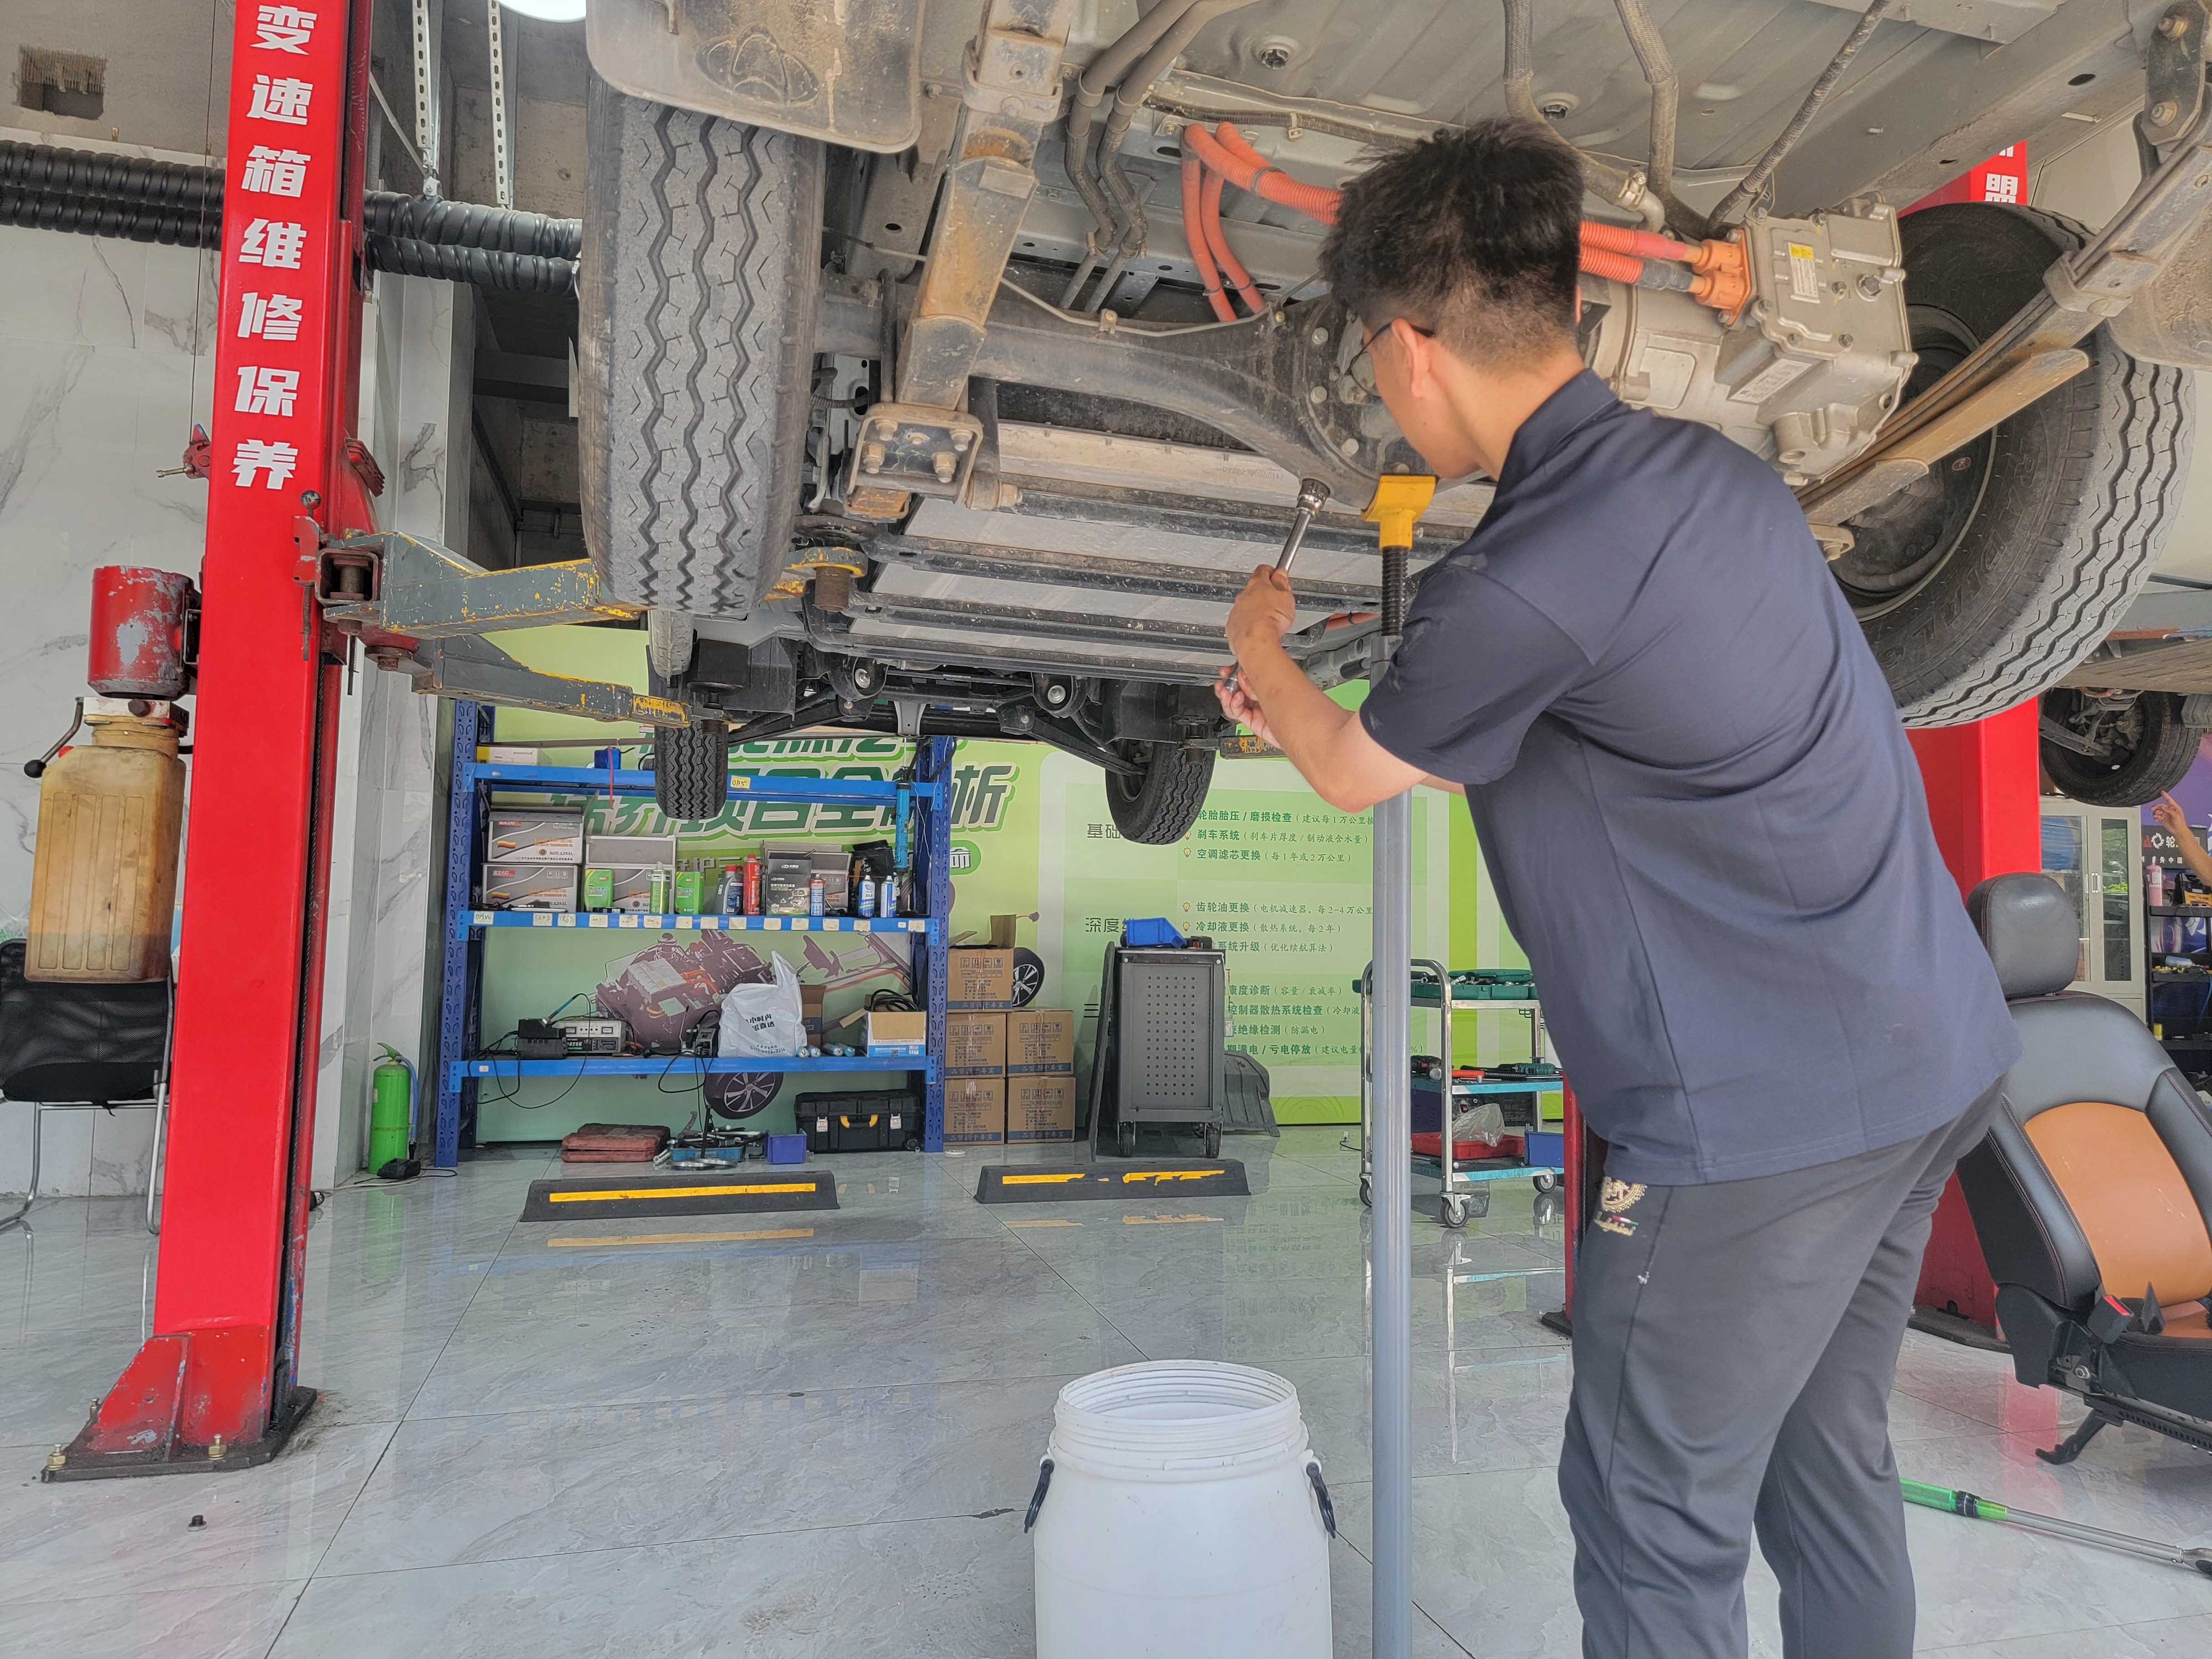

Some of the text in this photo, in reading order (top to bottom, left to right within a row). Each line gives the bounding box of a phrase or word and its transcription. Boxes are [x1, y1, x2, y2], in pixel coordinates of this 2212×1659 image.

[231, 5, 317, 490] 变速箱维修保养
[1087, 823, 1121, 838] 基础
